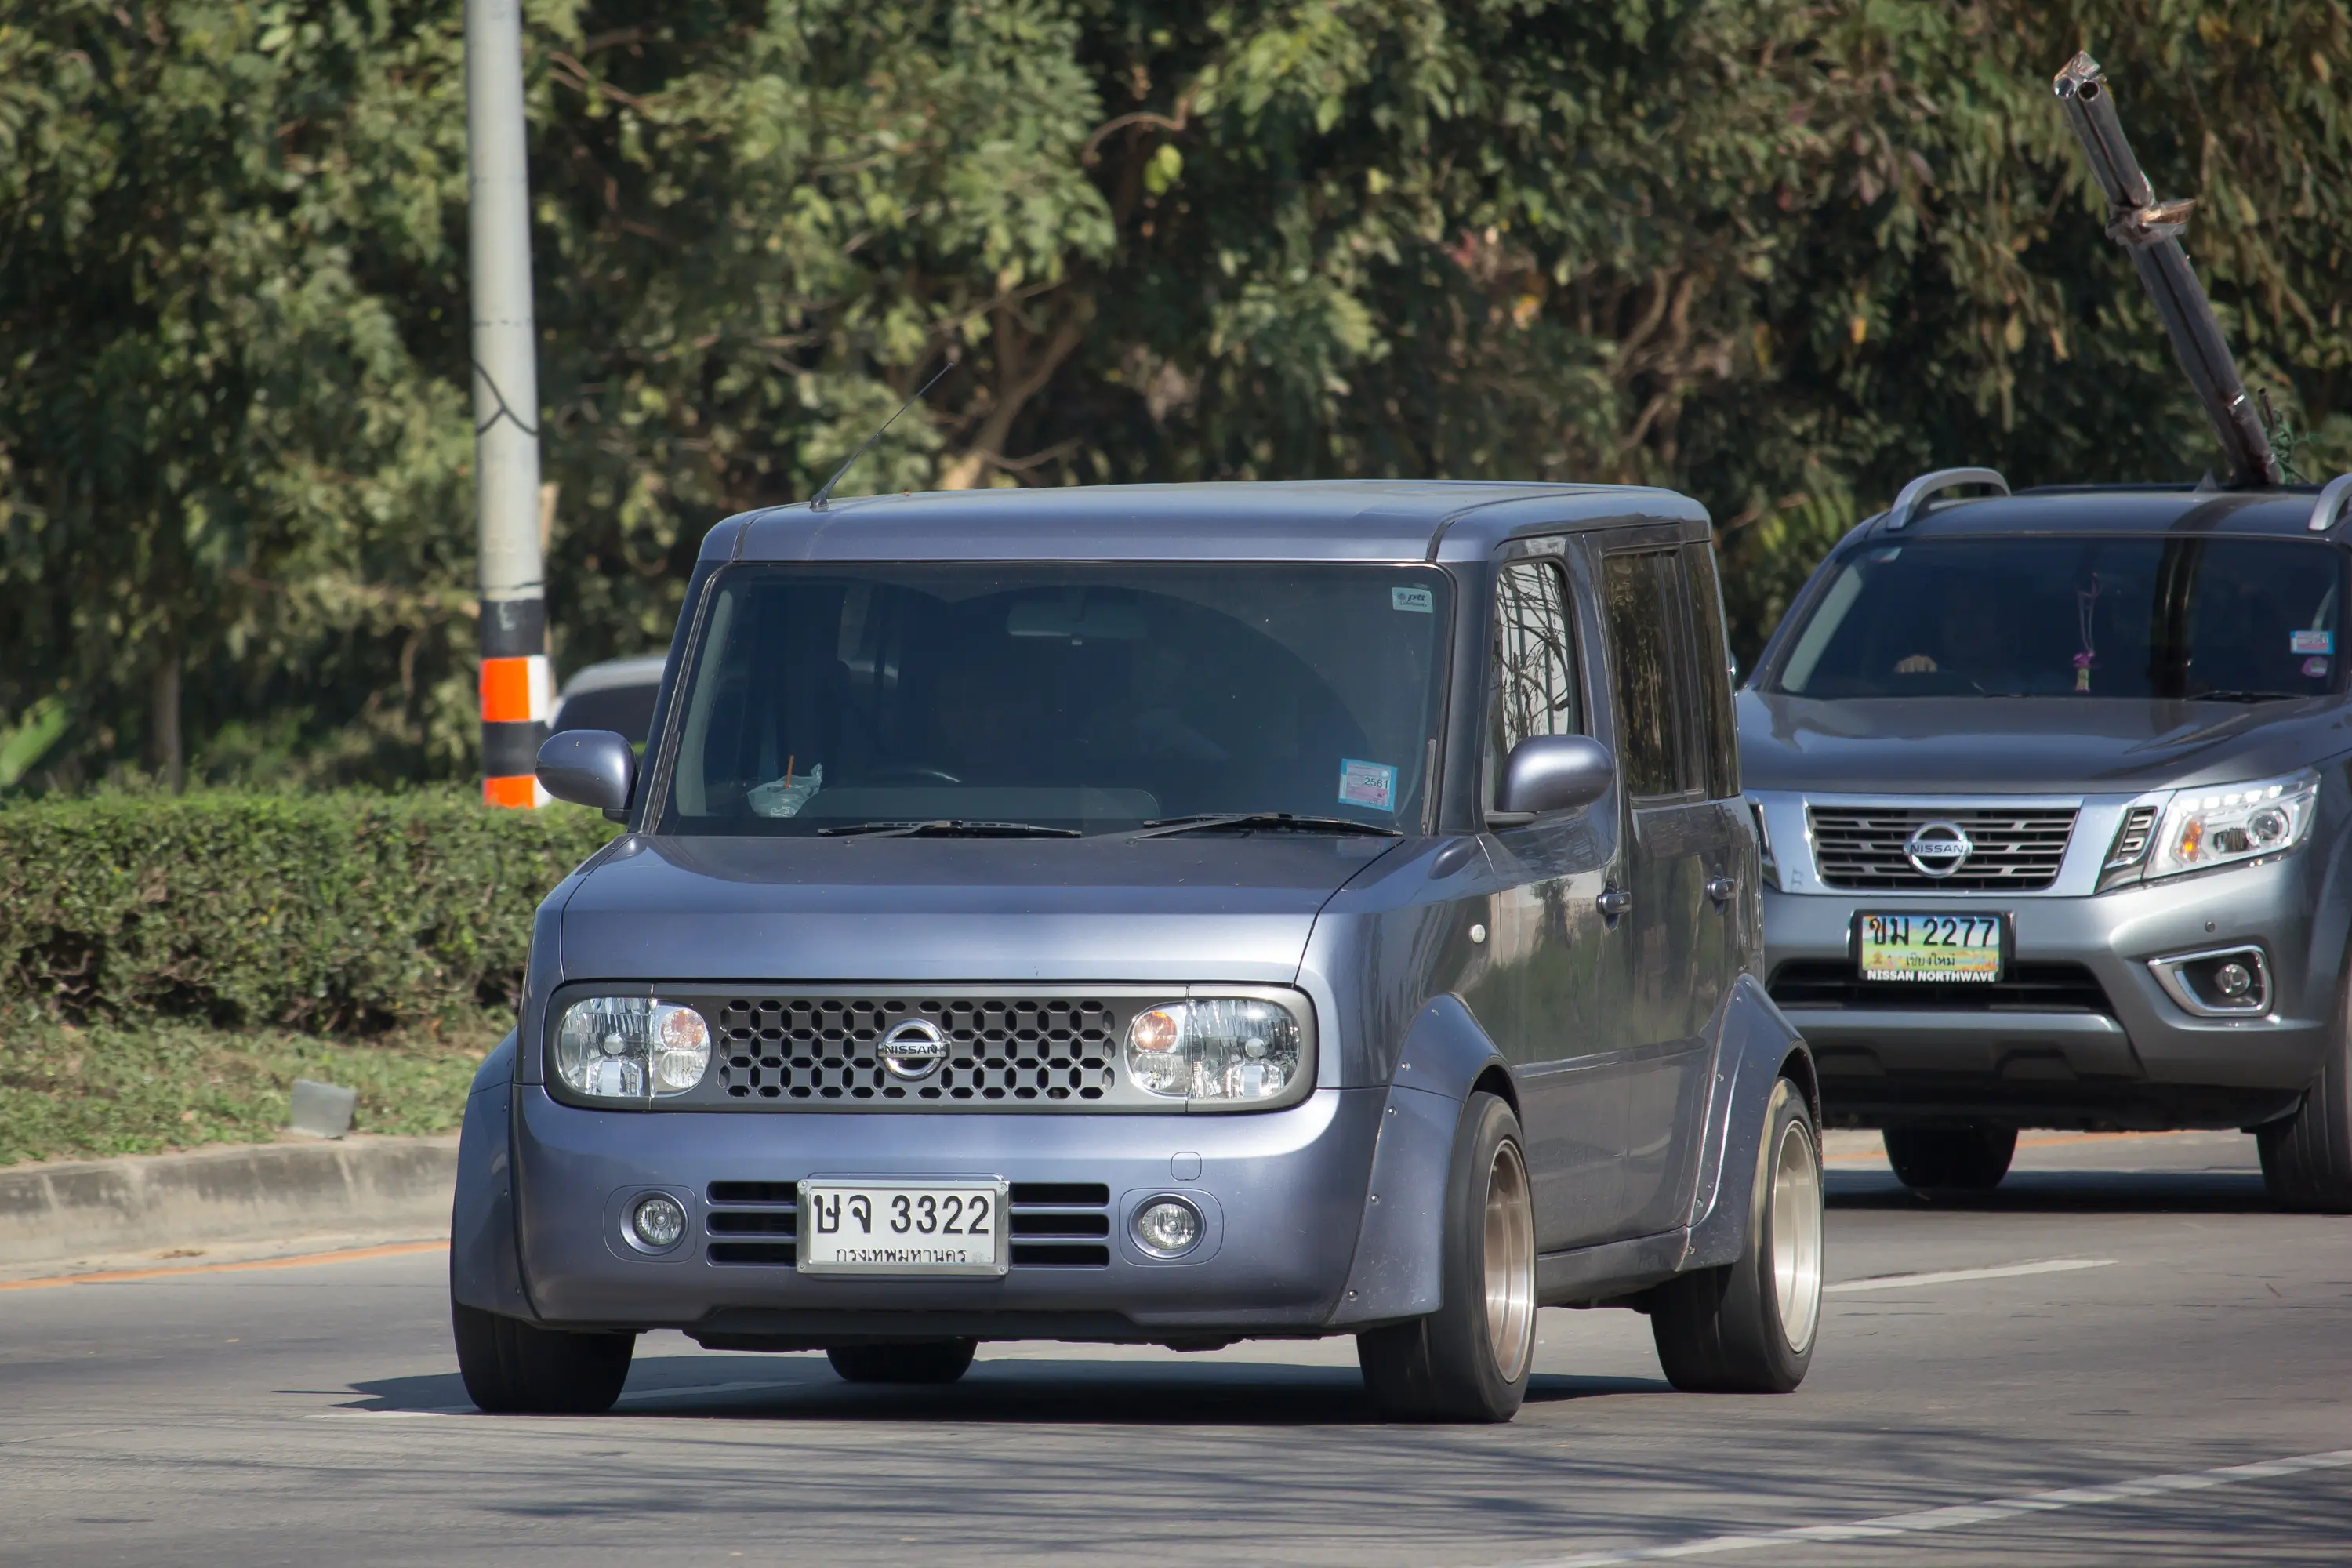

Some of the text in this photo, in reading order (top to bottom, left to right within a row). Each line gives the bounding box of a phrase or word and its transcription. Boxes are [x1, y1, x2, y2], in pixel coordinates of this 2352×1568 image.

[1364, 777, 1388, 789] 2561
[1910, 844, 1963, 853] NISSAN
[1923, 918, 1994, 947] 2277
[1867, 971, 1995, 982] NISSAN NORTHWAVE
[884, 1045, 938, 1054] NISSAN
[813, 1194, 989, 1234] ษจ 3322
[836, 1248, 967, 1262] กรงเทพมหานคร
